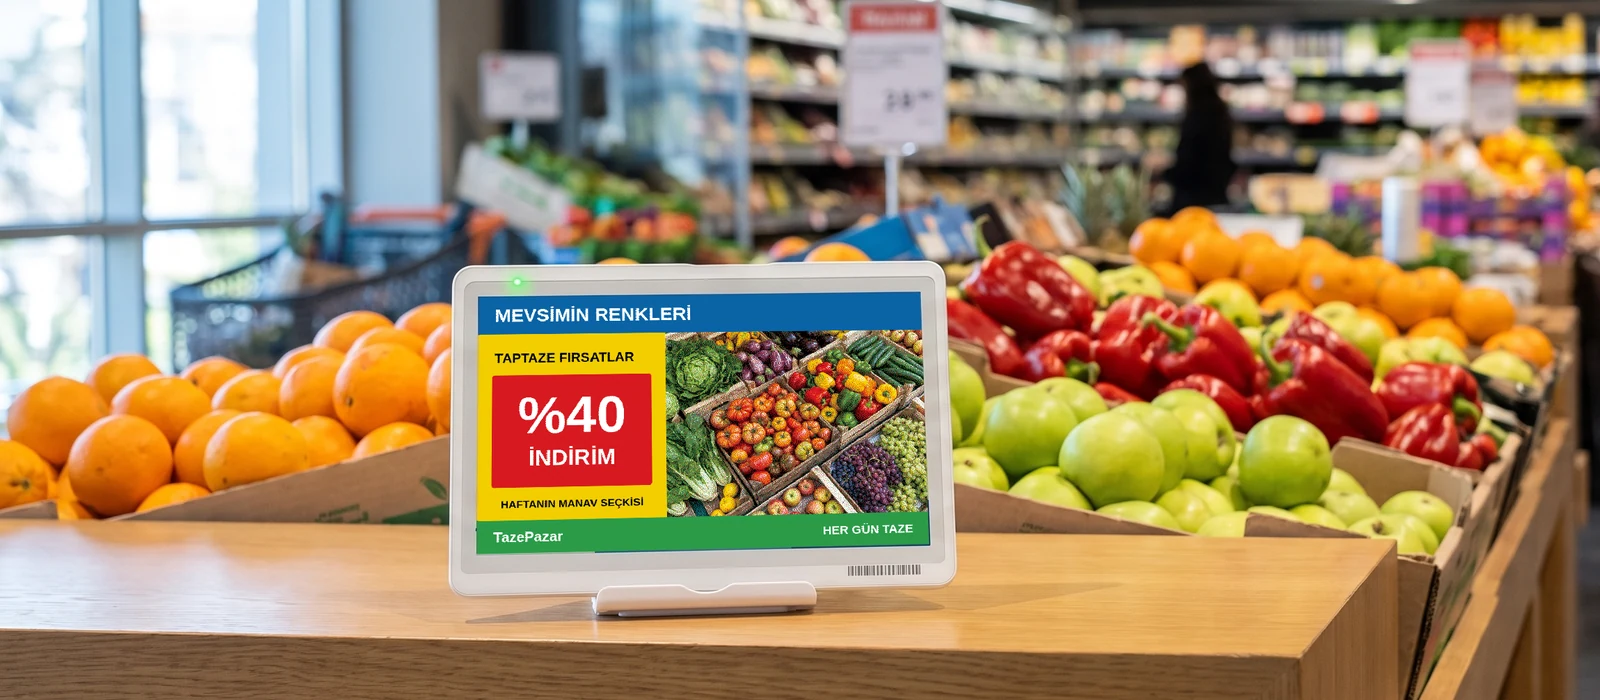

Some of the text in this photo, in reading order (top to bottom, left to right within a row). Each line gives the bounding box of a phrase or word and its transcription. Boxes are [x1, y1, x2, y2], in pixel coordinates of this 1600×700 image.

[495, 305, 691, 323] MEVSİMİN RENKLERİ
[494, 351, 634, 364] TAPTAZE FIRSATLAR
[518, 395, 625, 434] %40
[529, 446, 615, 467] İNDİRİM
[500, 497, 644, 509] HAFTANIN MANAV SEÇKİSİ
[823, 523, 914, 535] HER GÜN TAZE
[493, 531, 564, 543] TazePazar
